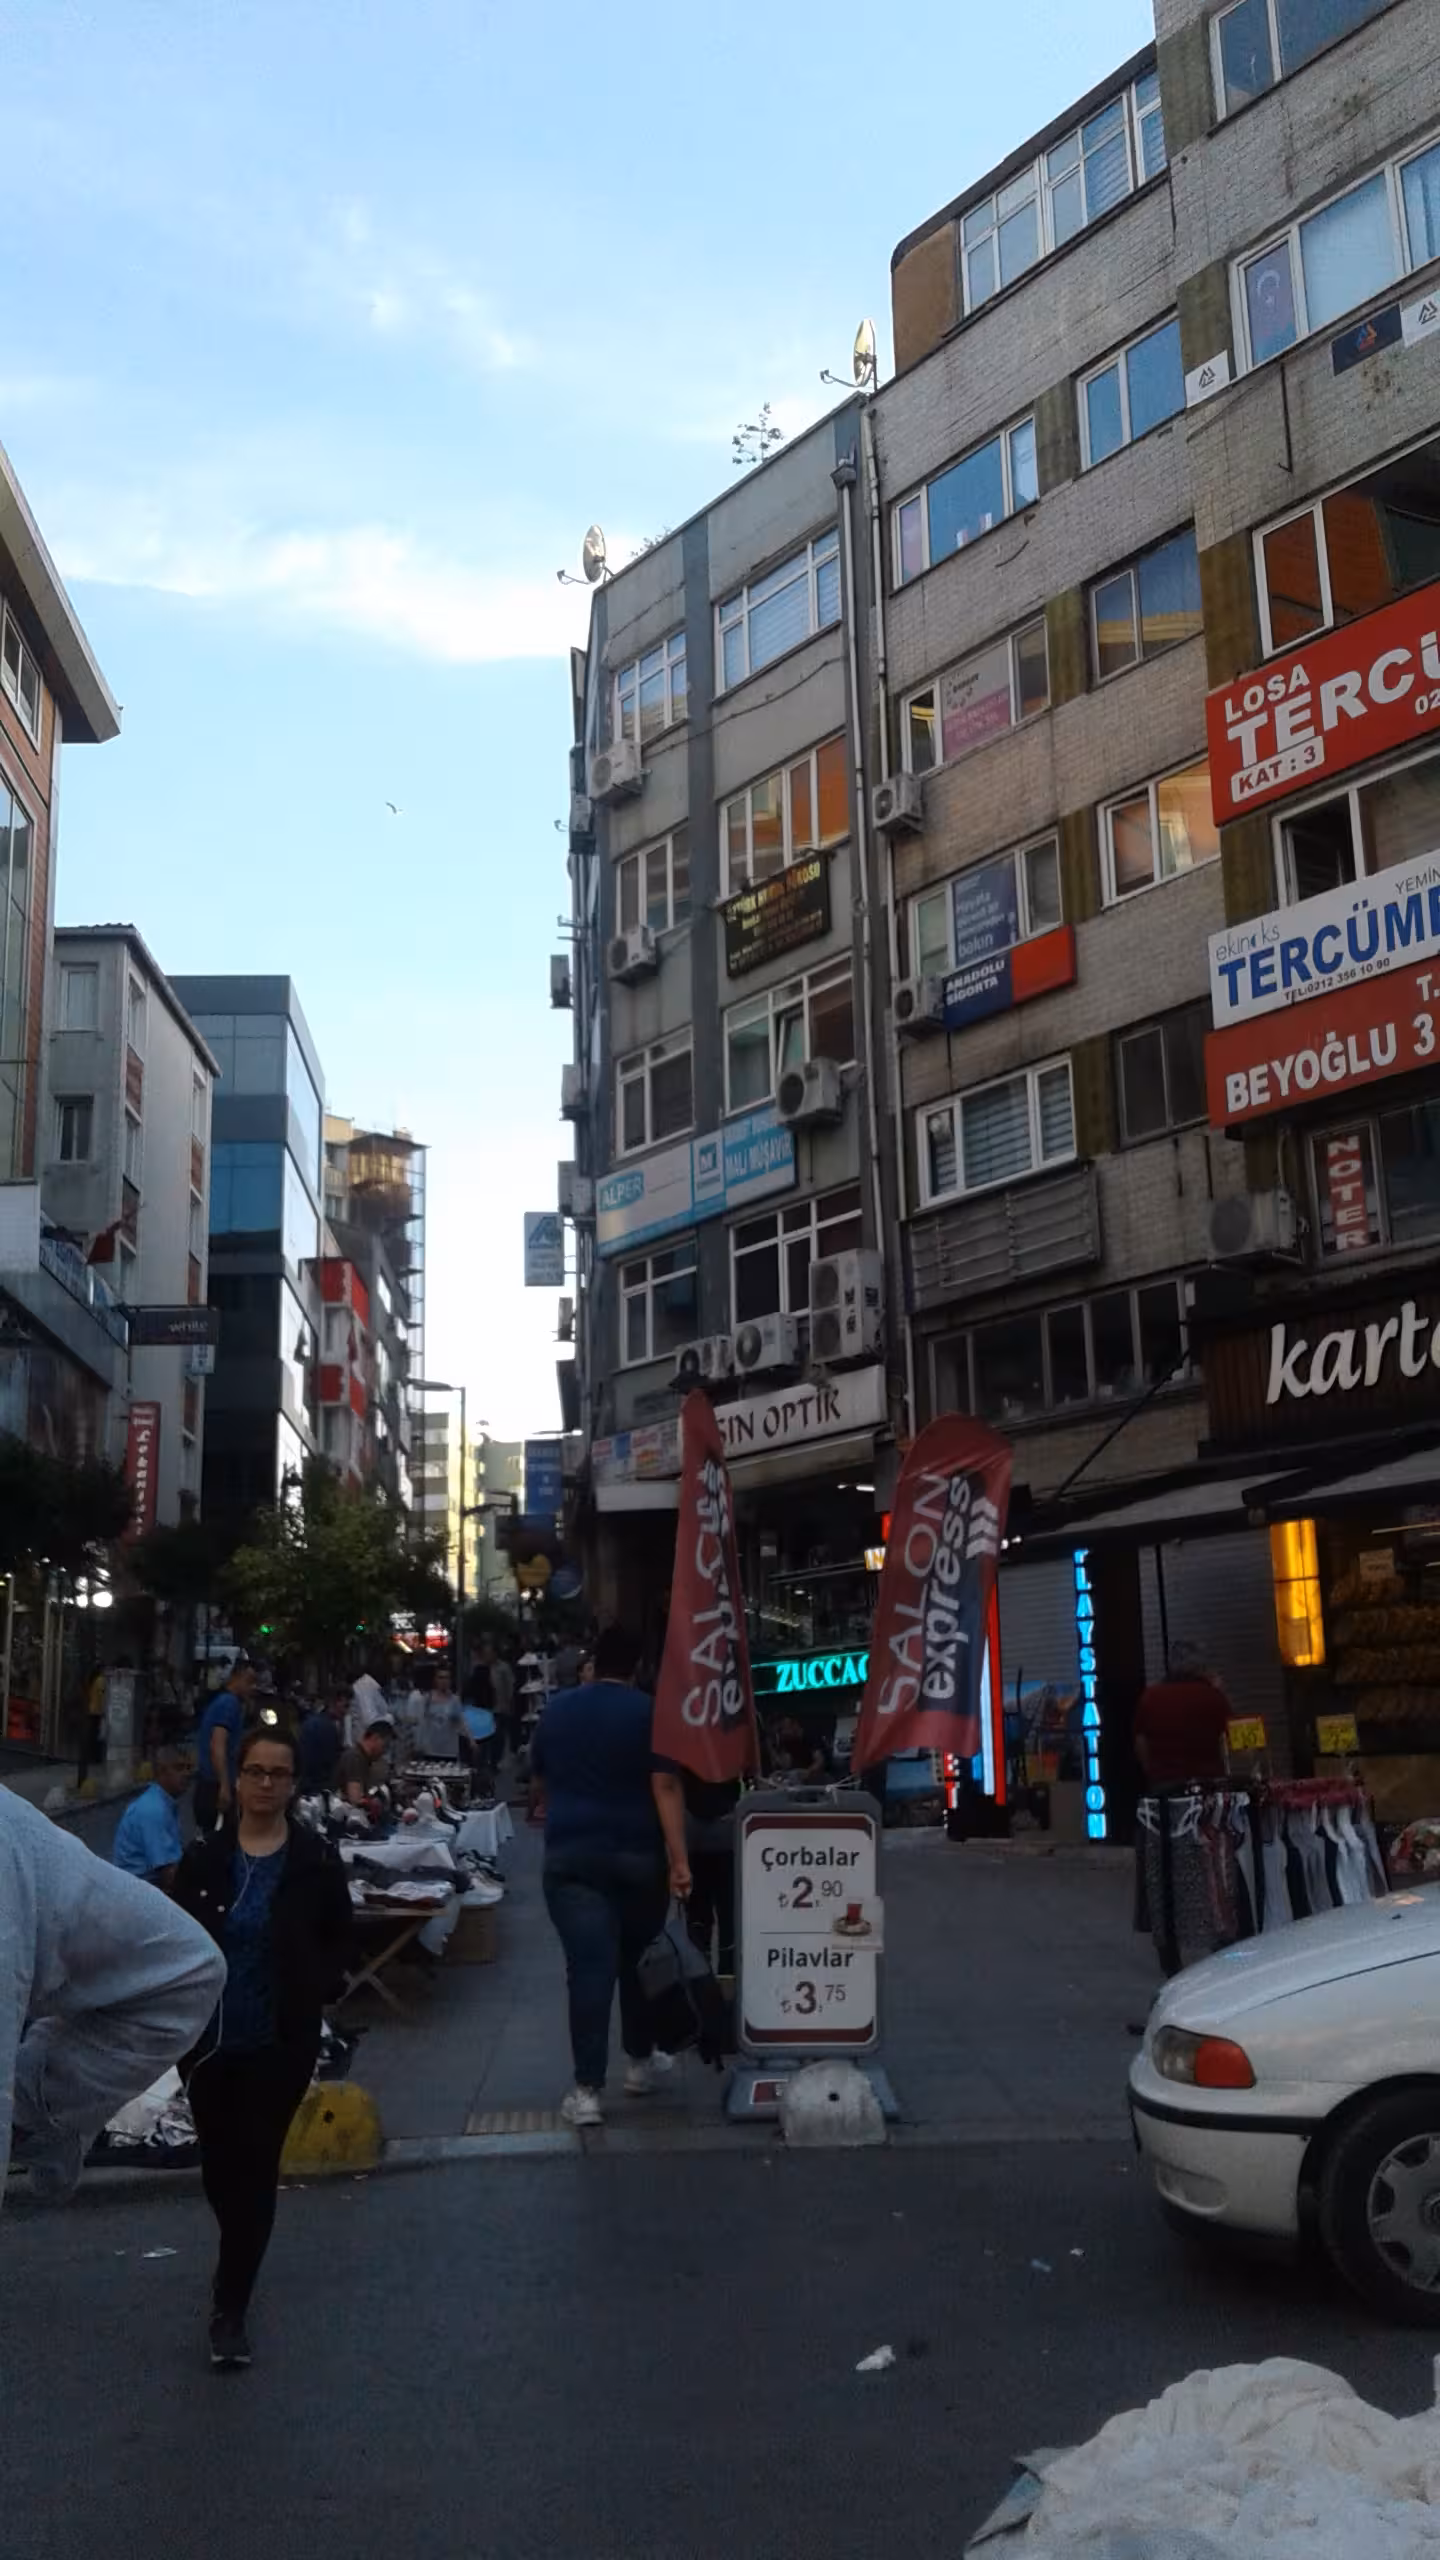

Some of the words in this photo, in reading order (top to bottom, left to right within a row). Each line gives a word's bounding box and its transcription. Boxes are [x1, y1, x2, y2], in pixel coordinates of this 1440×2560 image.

[1225, 664, 1310, 723] LOSA
[946, 960, 1005, 992] ANADOLU
[1361, 963, 1373, 975] 10
[1225, 1022, 1397, 1113] BEYOĞLU
[601, 1176, 643, 1206] ALPER
[1267, 1300, 1440, 1404] kart
[877, 1474, 950, 1715] SALON
[922, 1476, 970, 1699] express
[761, 1846, 860, 1872] Çorbalar
[768, 1947, 854, 1968] Pilavlar
